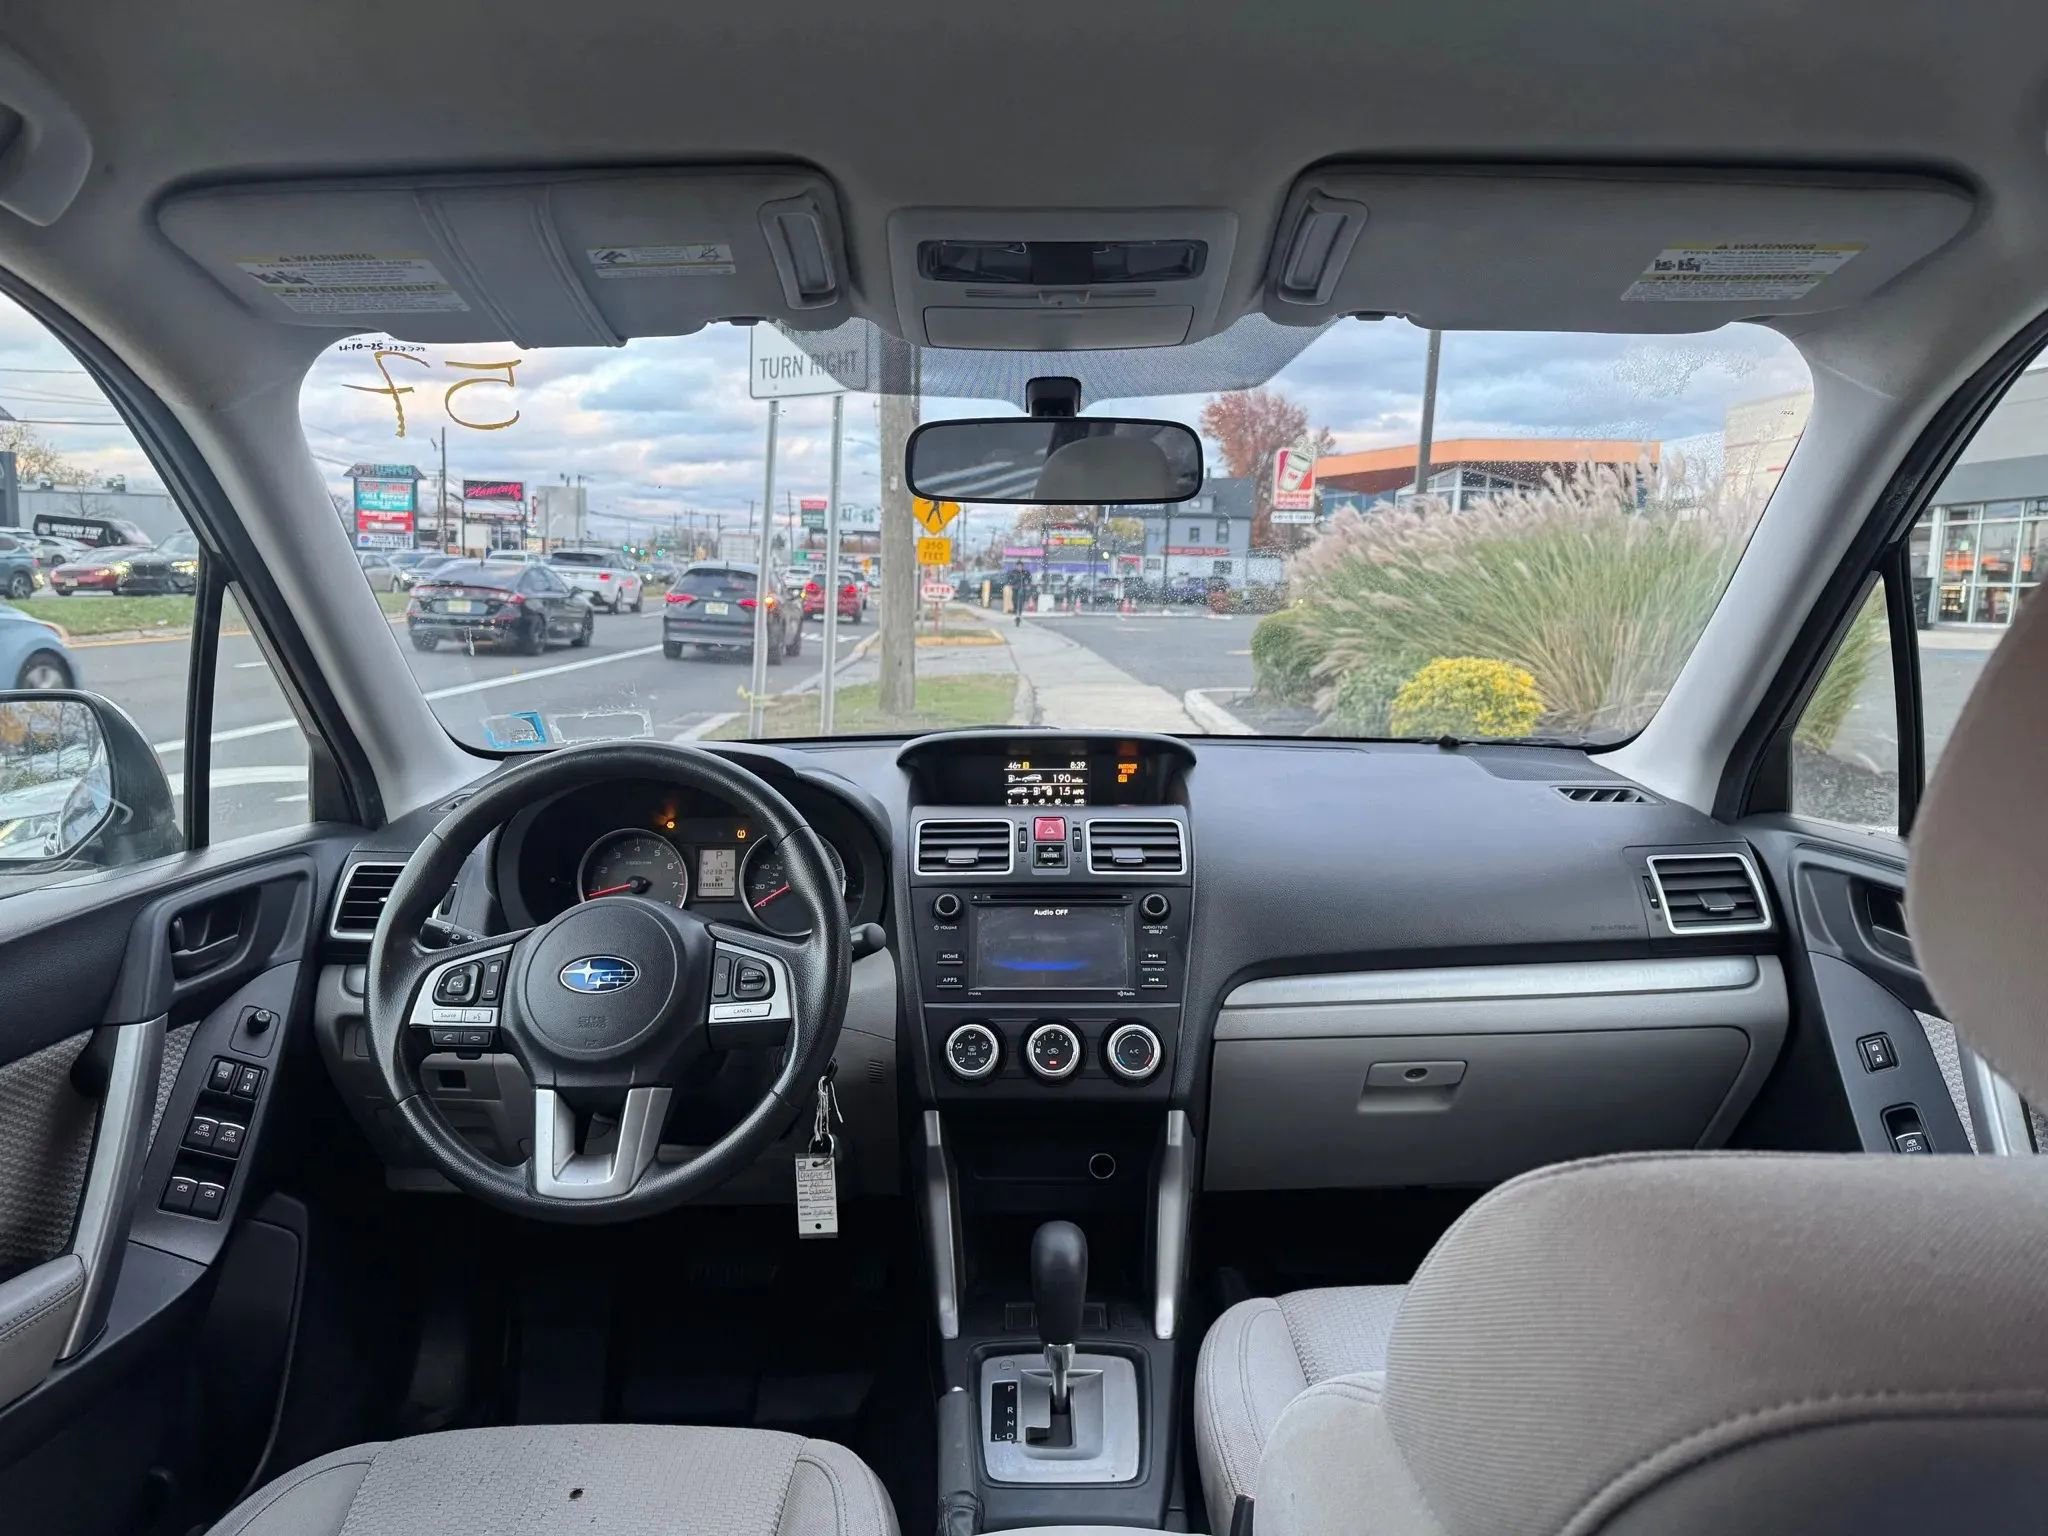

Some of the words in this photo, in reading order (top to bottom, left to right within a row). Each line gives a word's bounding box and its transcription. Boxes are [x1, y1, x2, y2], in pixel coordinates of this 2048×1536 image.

[760, 356, 803, 380] TURN
[810, 351, 857, 377] RIGHT
[924, 552, 944, 560] FEET
[1070, 761, 1086, 769] 8:39
[1053, 774, 1071, 783] 190
[654, 849, 661, 857] 5
[716, 850, 723, 860] P
[600, 866, 608, 874] 2
[1007, 1406, 1013, 1414] R
